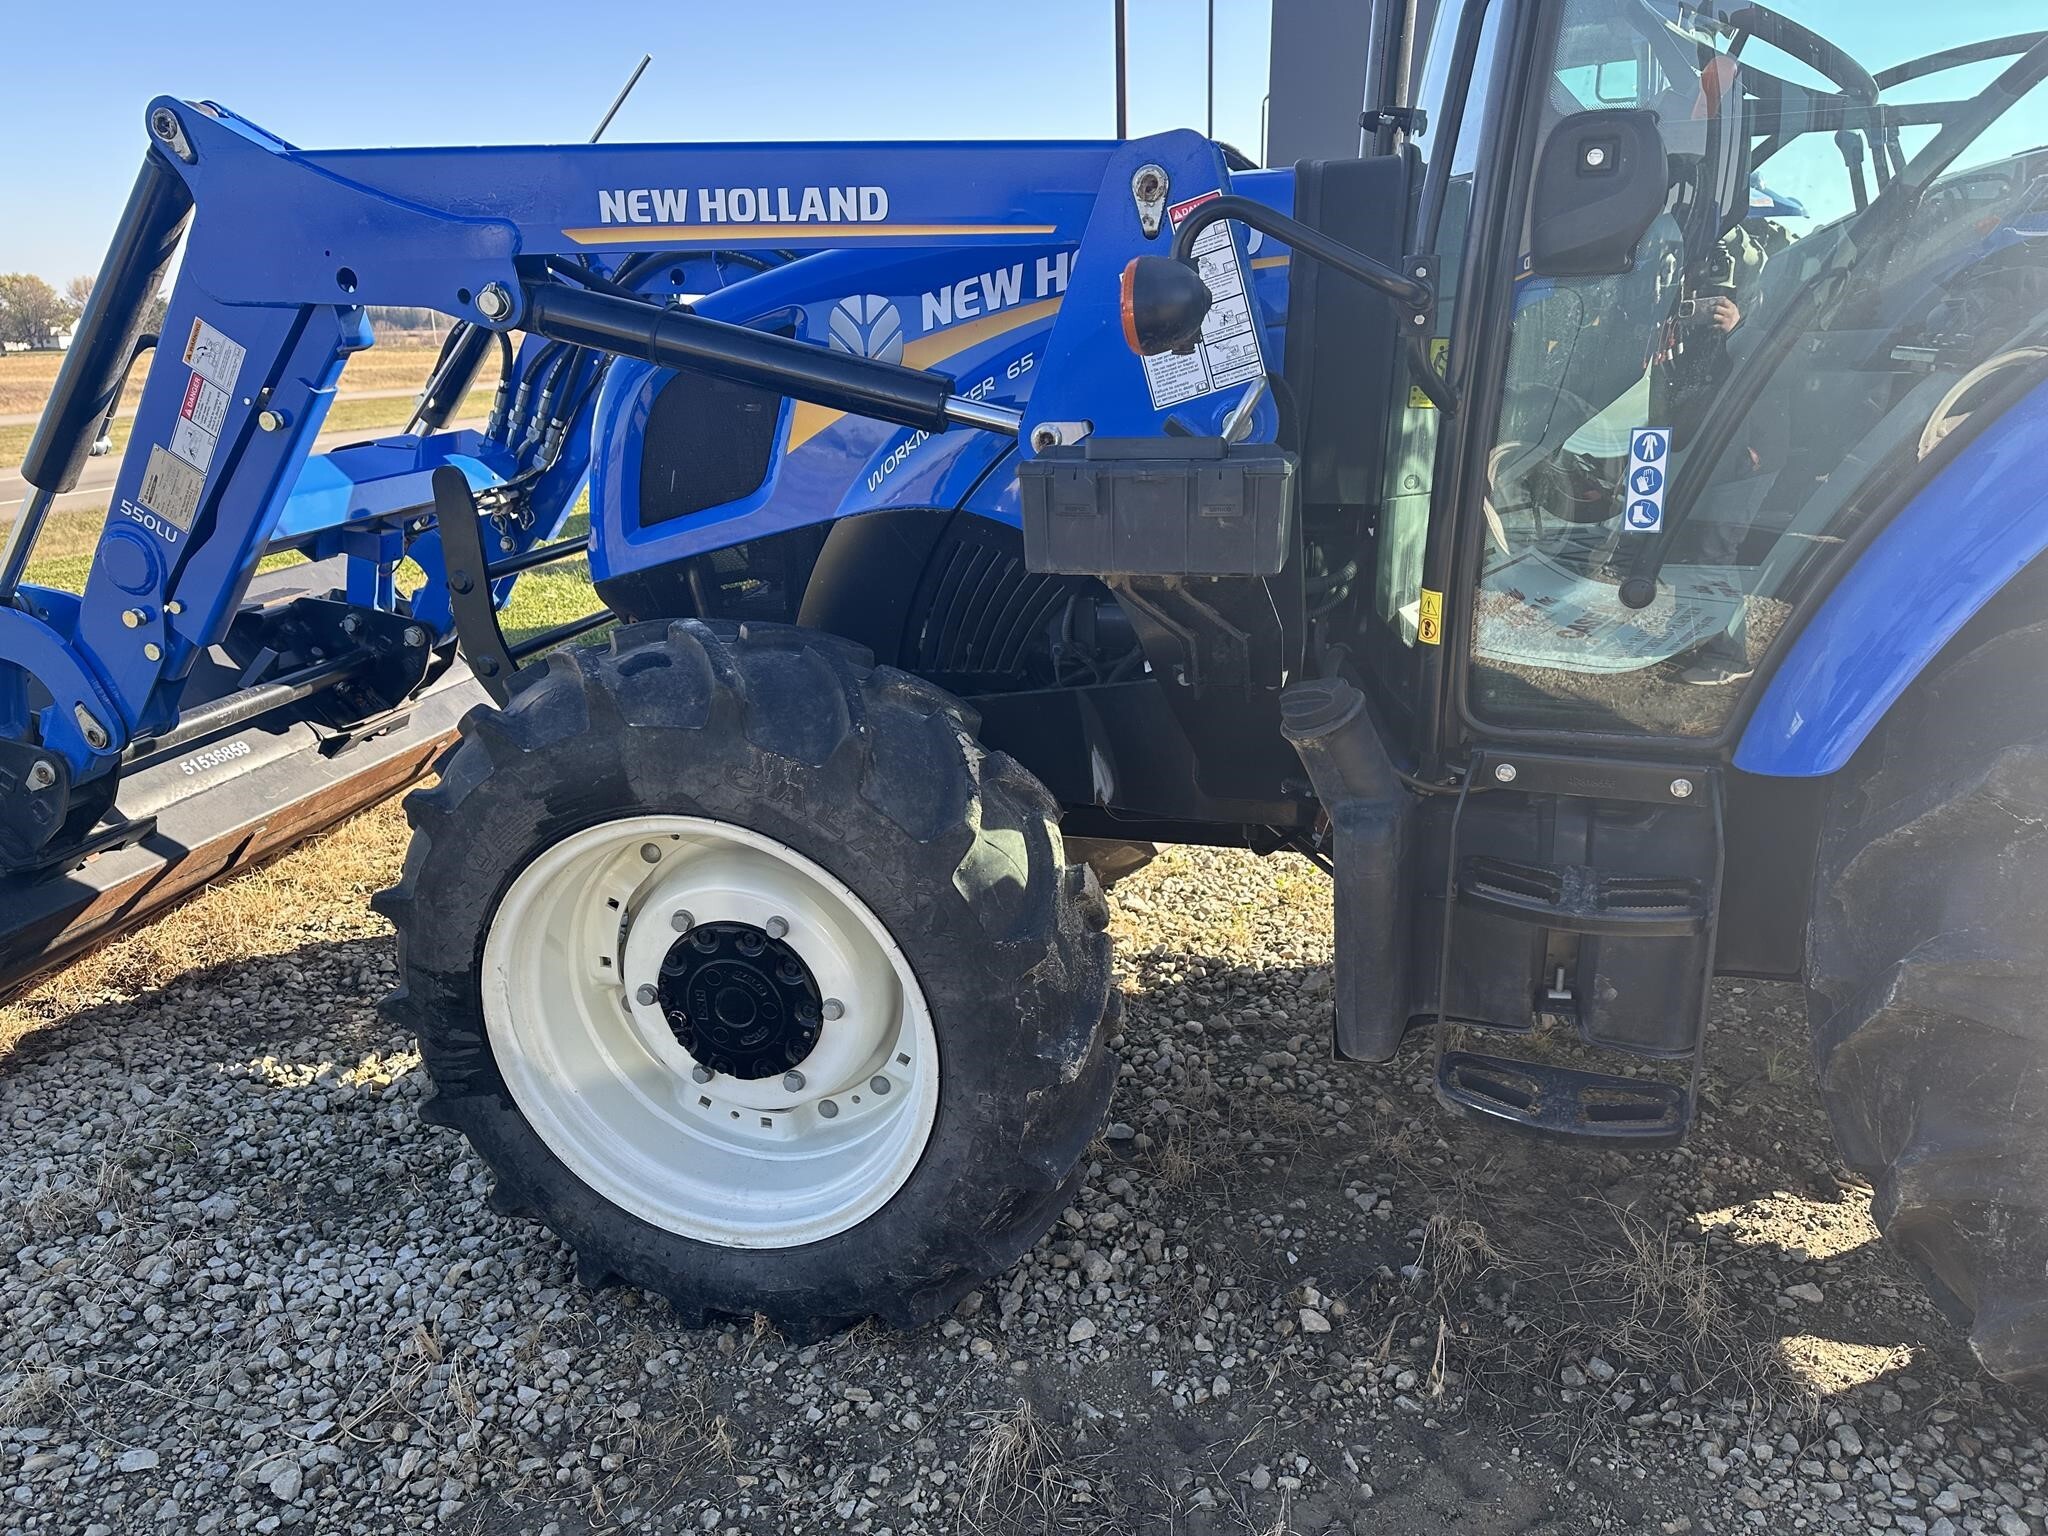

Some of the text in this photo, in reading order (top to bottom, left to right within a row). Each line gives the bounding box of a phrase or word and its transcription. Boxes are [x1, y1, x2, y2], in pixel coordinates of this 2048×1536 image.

[599, 186, 889, 223] NEW HOLLAND
[921, 263, 1024, 332] NEW
[1006, 352, 1034, 380] 65
[189, 377, 203, 408] DANGER
[120, 499, 178, 543] 550LU
[180, 741, 251, 775] 51536859
